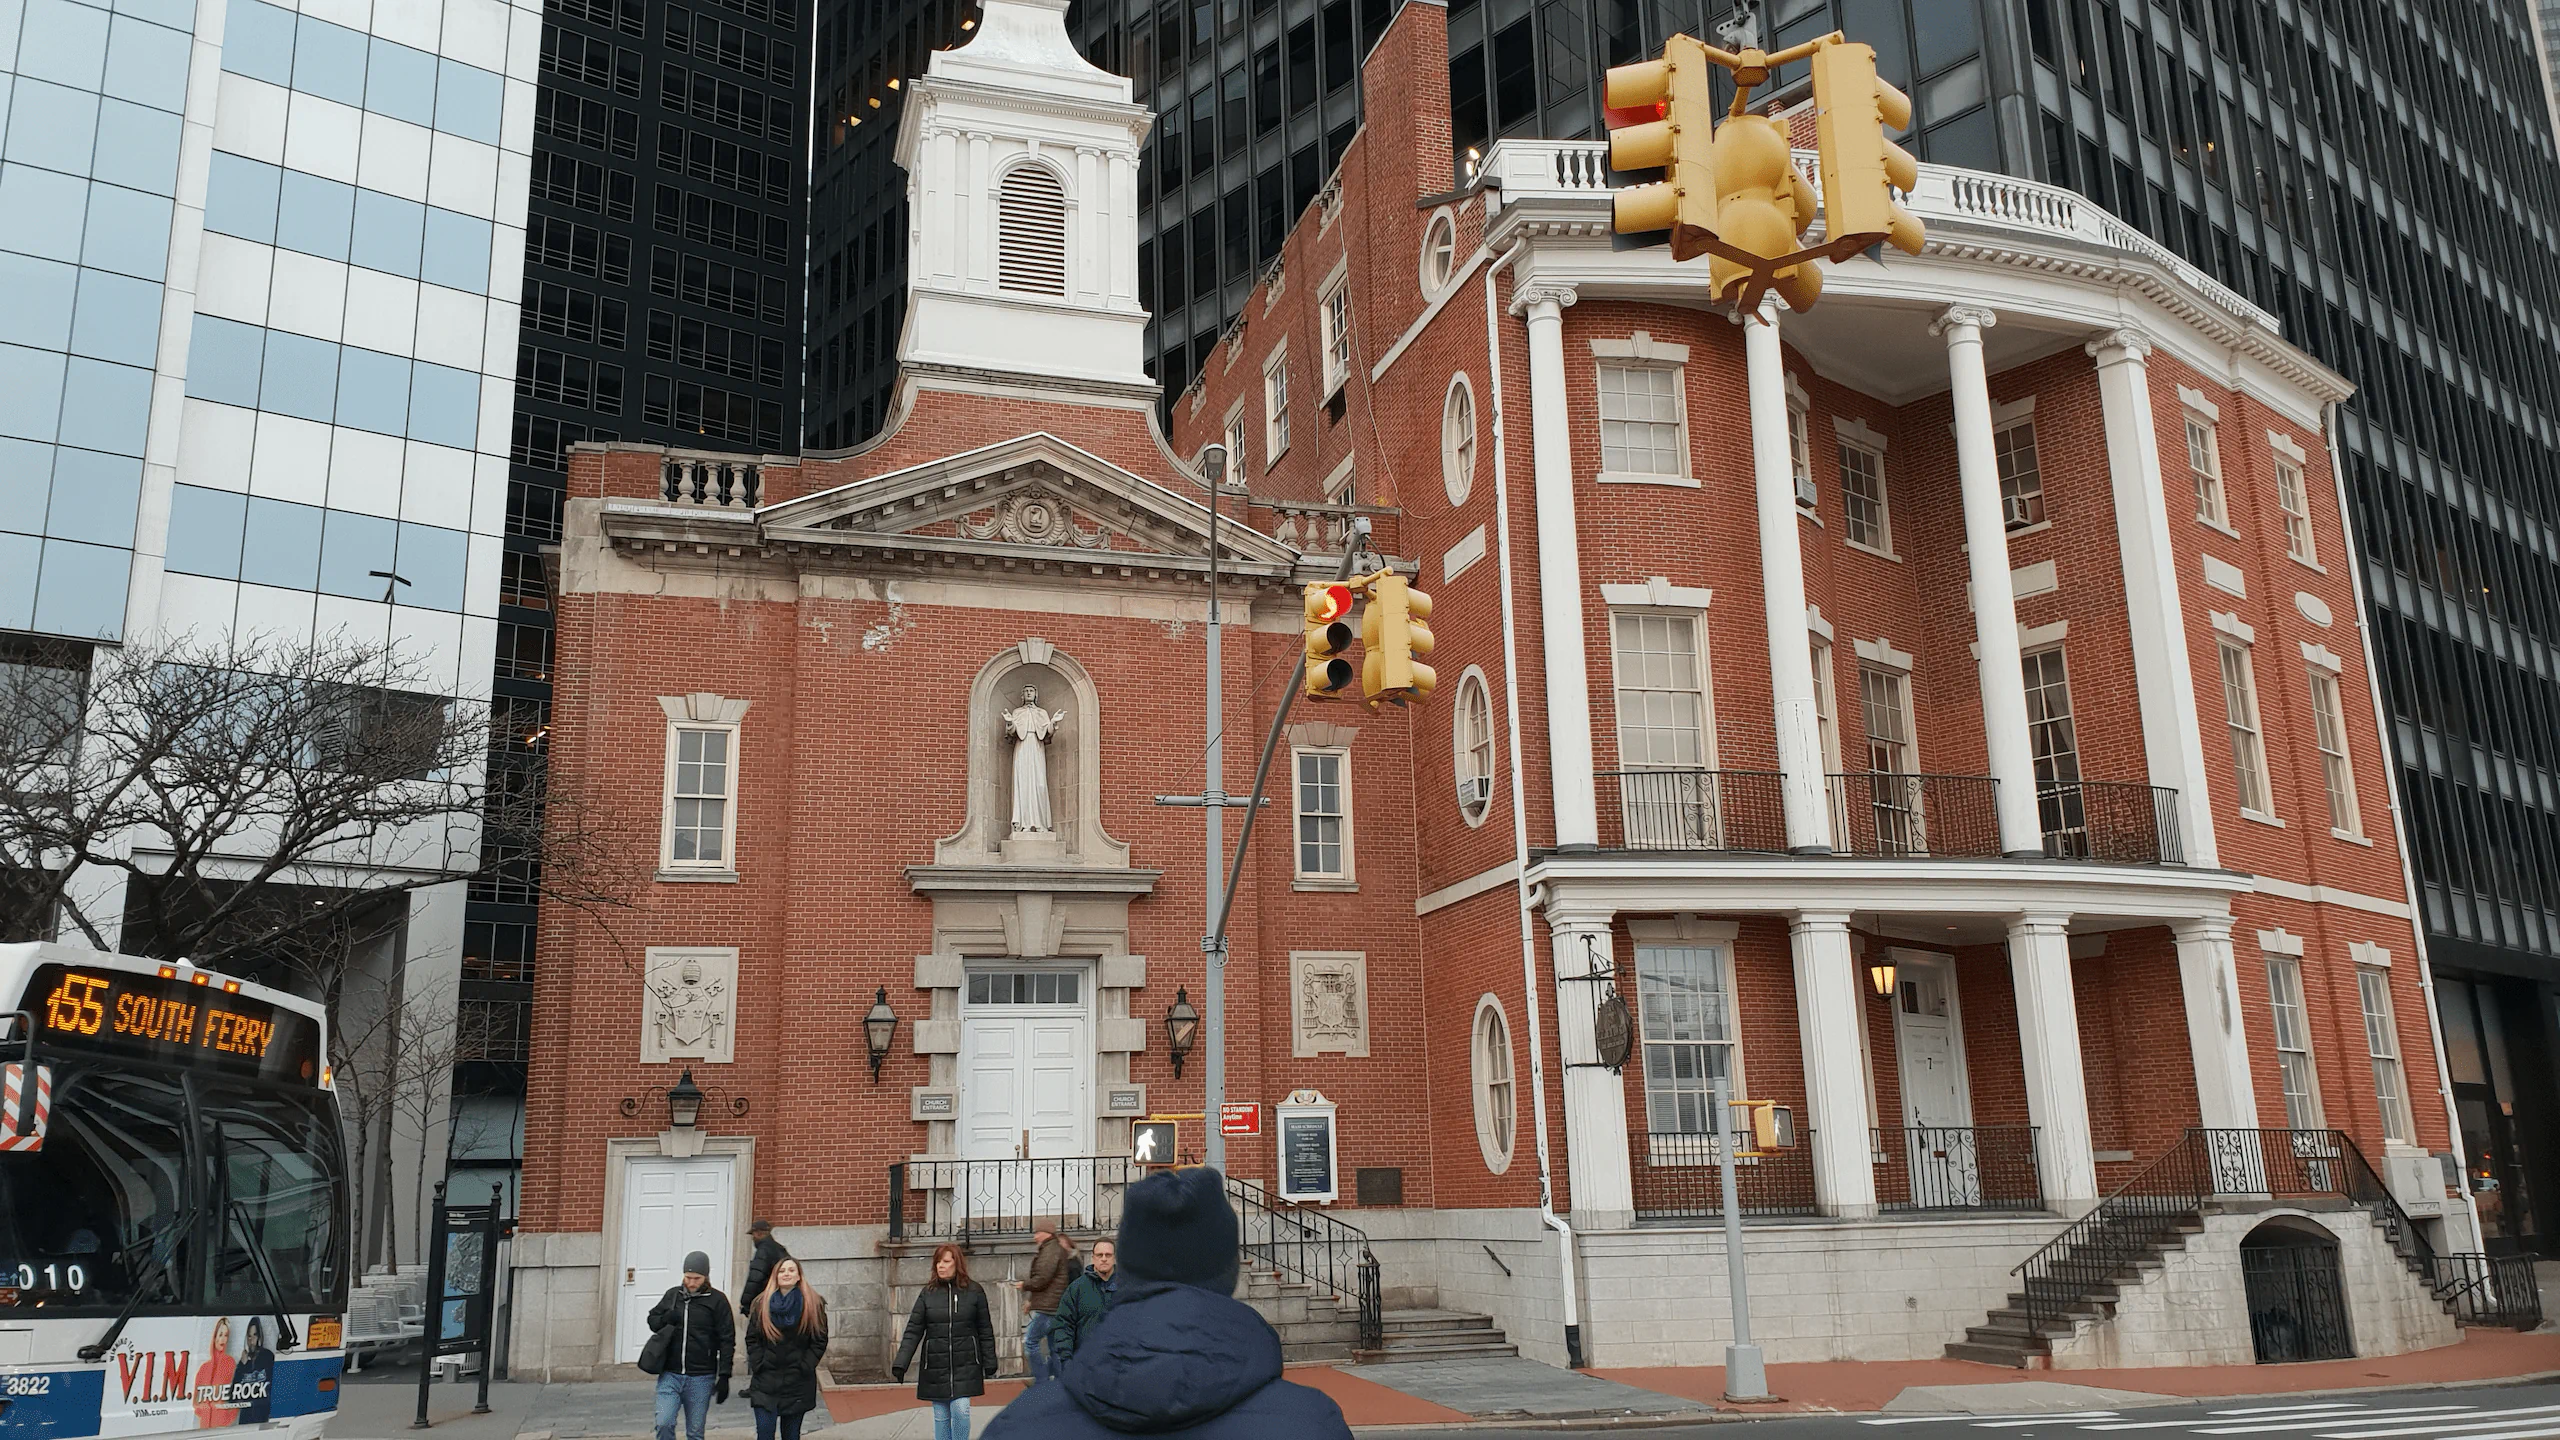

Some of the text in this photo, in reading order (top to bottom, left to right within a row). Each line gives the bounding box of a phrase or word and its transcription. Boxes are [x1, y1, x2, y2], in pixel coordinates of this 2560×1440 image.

[113, 992, 197, 1044] SOUTH
[202, 1009, 275, 1057] FERRY
[1223, 1113, 1243, 1121] Anytime
[109, 1337, 128, 1362] WINNING
[6, 1376, 51, 1395] 3822
[117, 1350, 192, 1404] V.I.M.
[197, 1381, 270, 1402] TRUE ROCK
[132, 1409, 169, 1418] VIM.com
